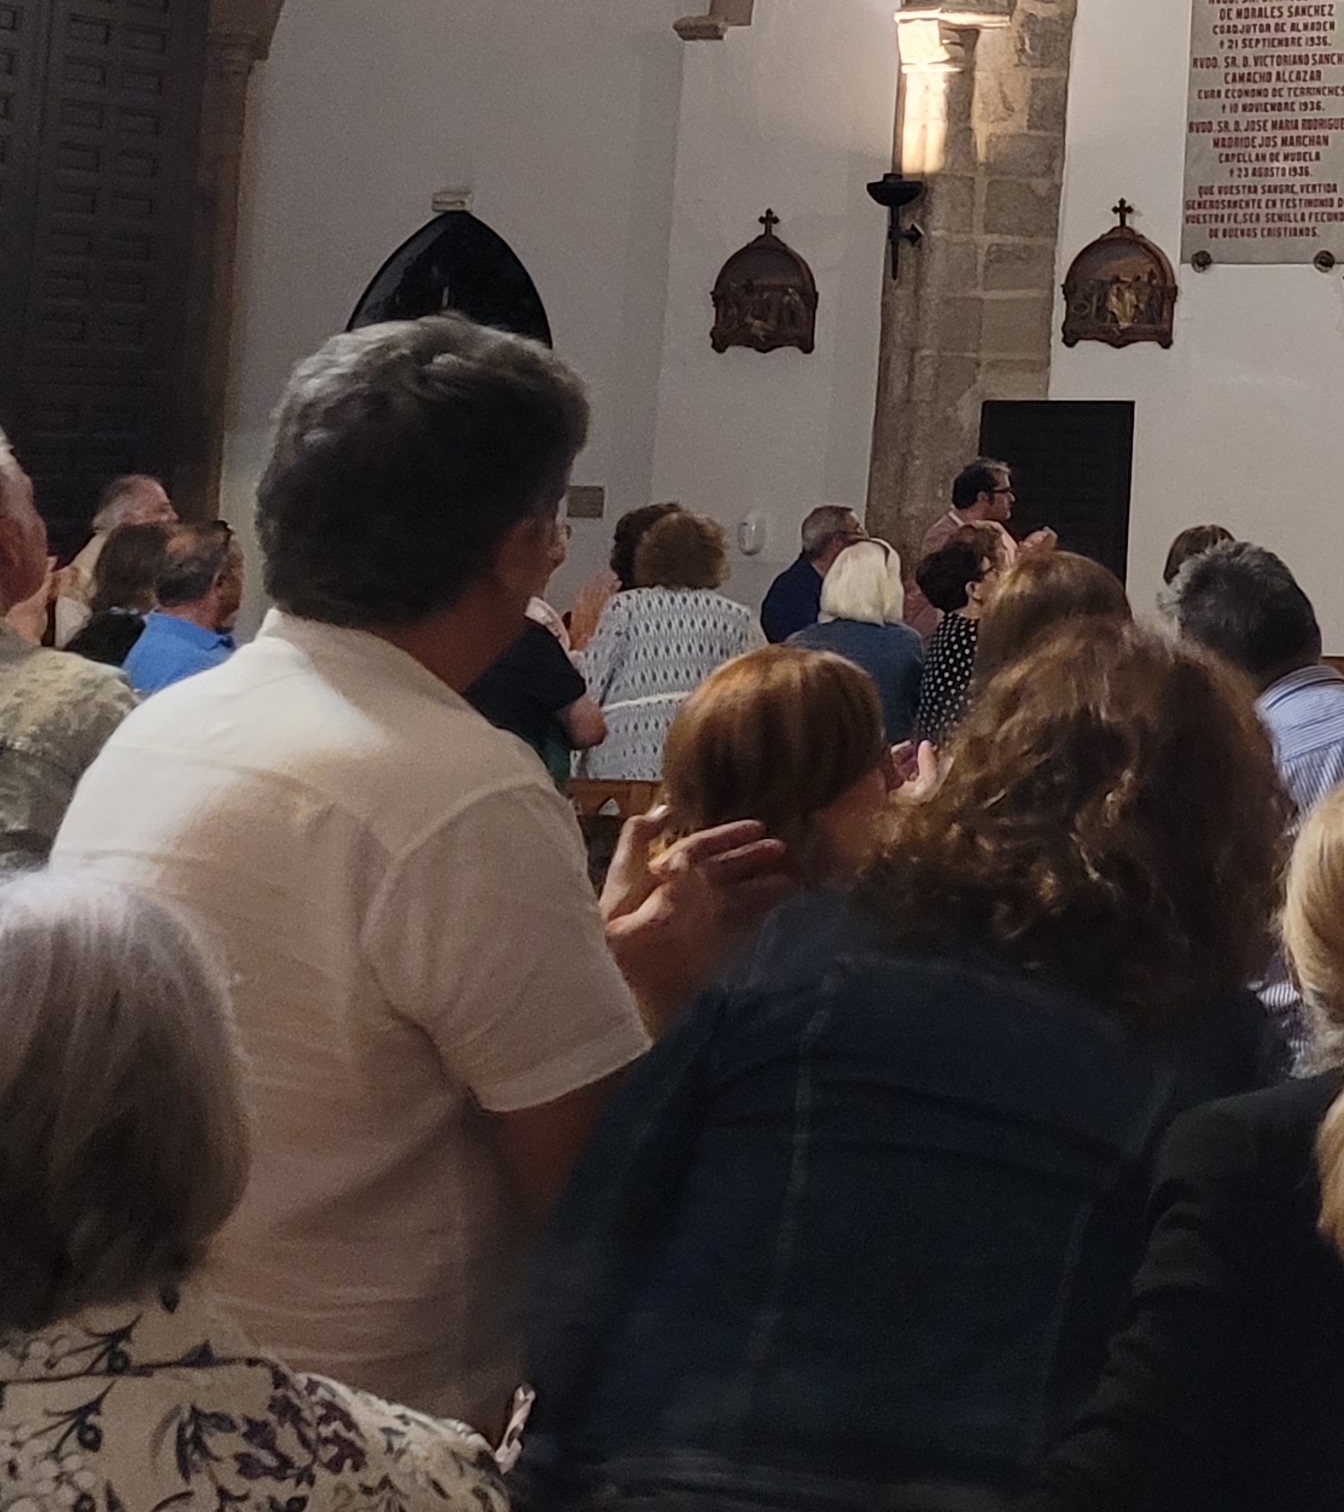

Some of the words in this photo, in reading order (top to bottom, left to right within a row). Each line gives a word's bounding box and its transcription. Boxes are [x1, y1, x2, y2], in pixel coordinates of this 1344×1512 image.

[1220, 8, 1233, 21] DE
[1236, 6, 1284, 20] MORALES
[1287, 4, 1334, 18] SANCHEZ
[1213, 23, 1271, 36] COADJUTOR
[1274, 22, 1287, 33] DE
[1241, 37, 1302, 49] SEPTIEMBRE
[1225, 71, 1273, 85] CAMACHO
[1276, 70, 1321, 83] ALCAZAR
[1198, 89, 1221, 100] CURA
[1225, 88, 1268, 99] ECONOMO
[1243, 120, 1268, 133] JOSE
[1271, 119, 1299, 132] MARIA
[1281, 135, 1329, 148] MARCHAN
[1219, 152, 1266, 164] CAPELLAN
[1251, 167, 1286, 178] AGOSTO
